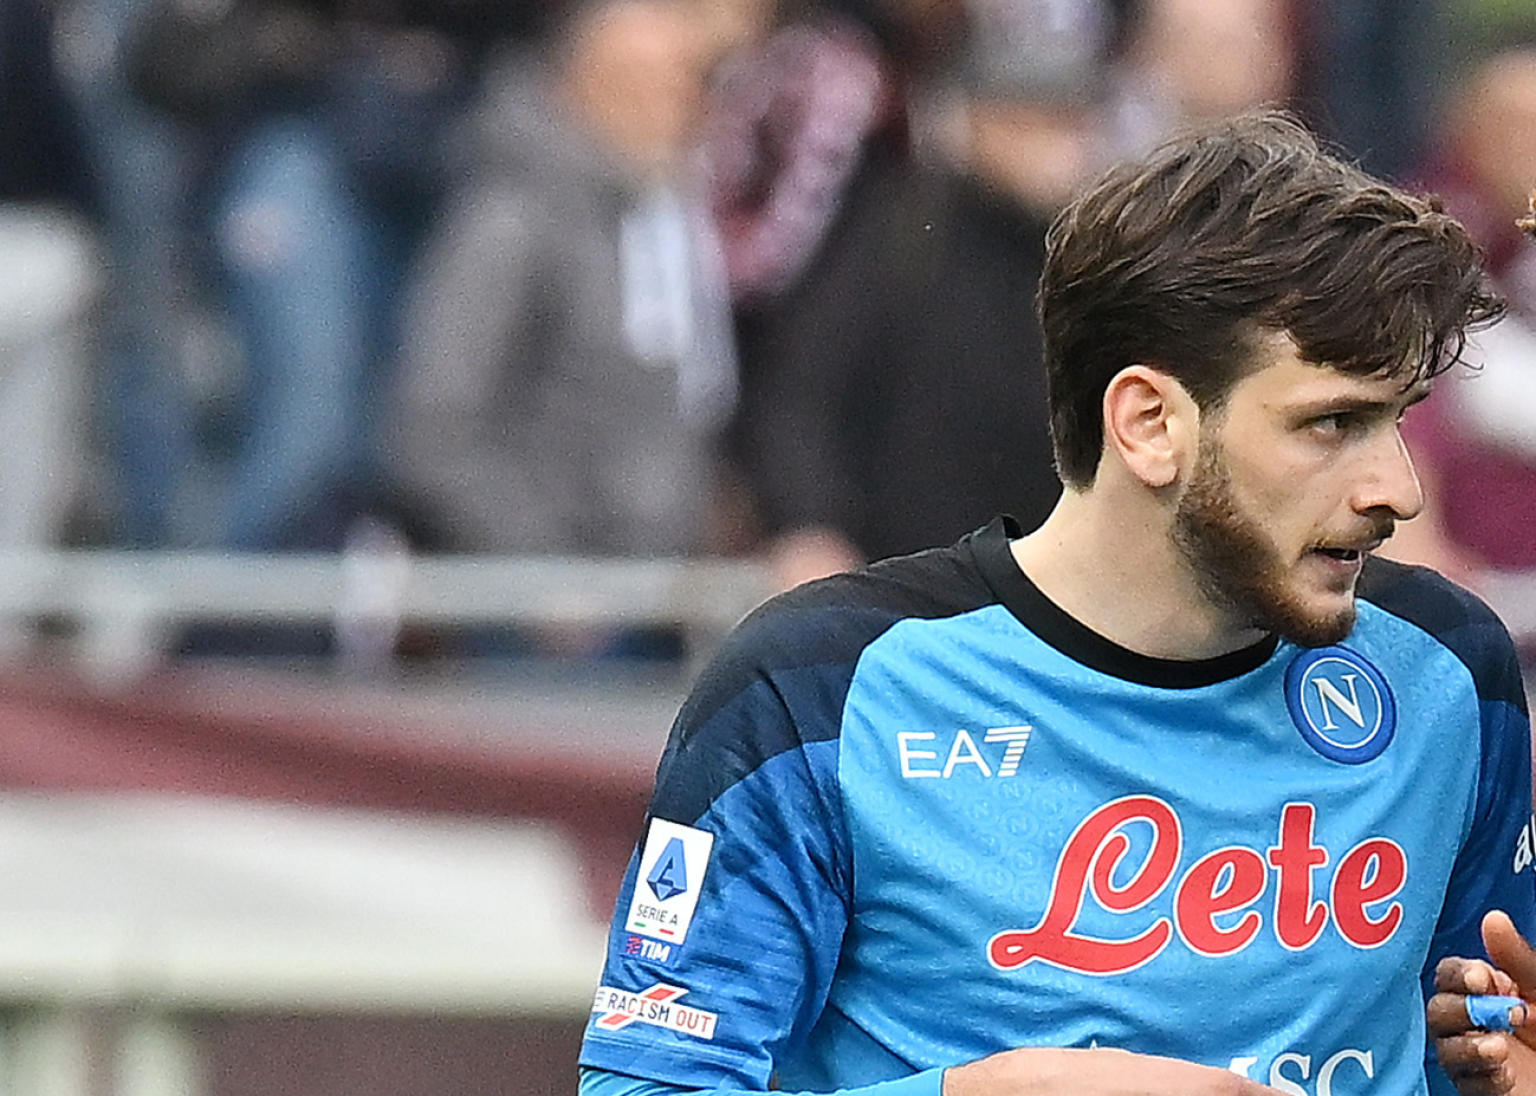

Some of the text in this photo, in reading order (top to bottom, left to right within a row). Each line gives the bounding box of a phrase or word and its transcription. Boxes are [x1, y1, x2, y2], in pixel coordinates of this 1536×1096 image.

[1311, 674, 1365, 731] N
[897, 725, 1033, 779] EA7
[986, 795, 1408, 977] Lete
[636, 903, 679, 927] SERIE A
[640, 940, 671, 963] TIM
[607, 992, 671, 1024] RACISM
[675, 1009, 713, 1034] OUT
